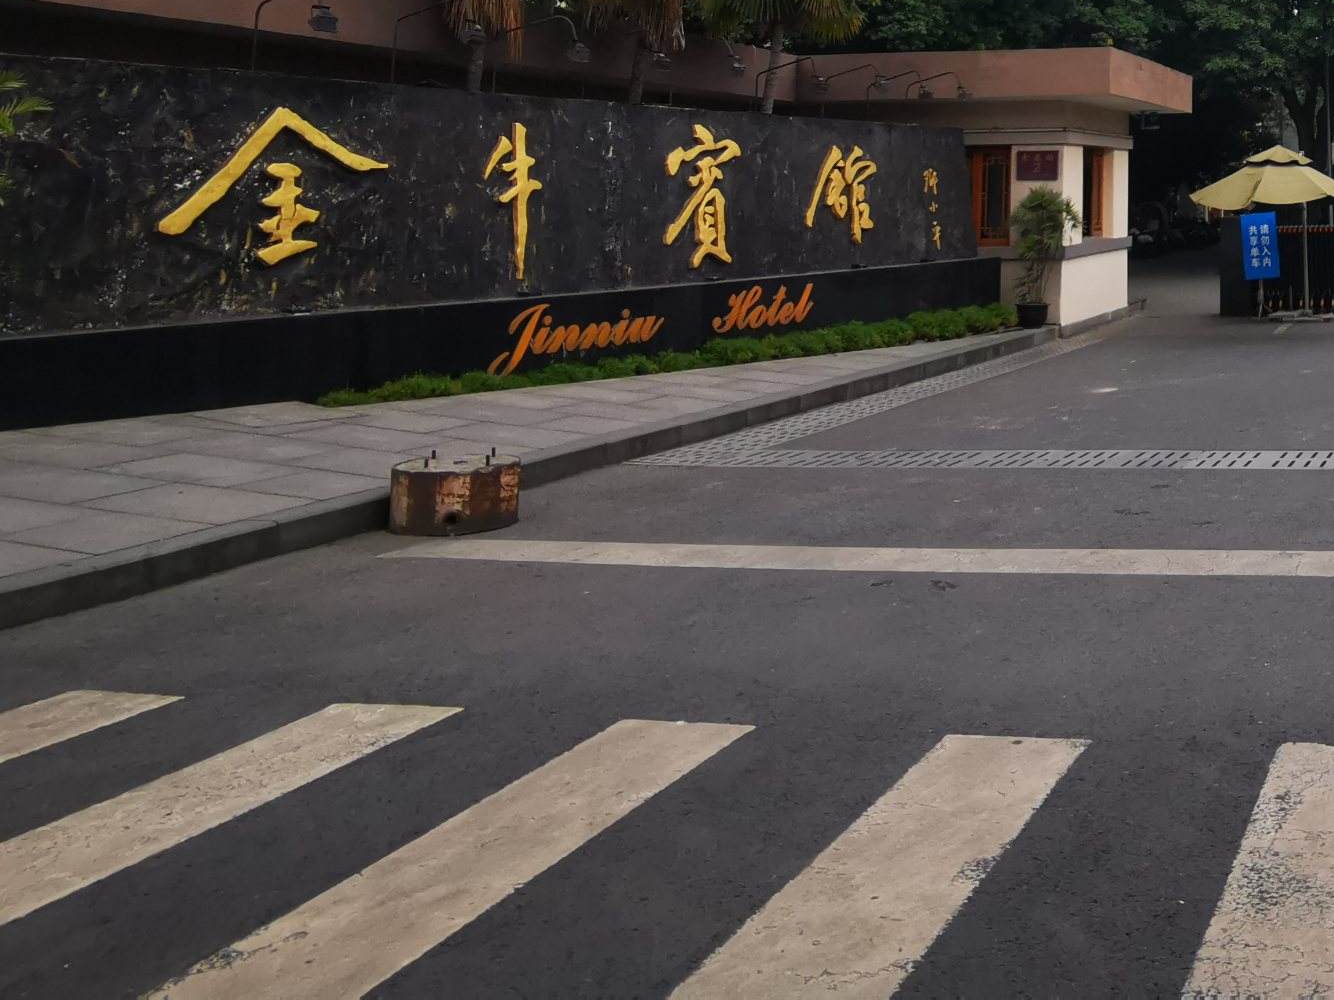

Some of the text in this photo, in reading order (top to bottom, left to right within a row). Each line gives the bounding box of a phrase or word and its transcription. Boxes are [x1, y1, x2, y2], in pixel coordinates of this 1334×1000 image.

[1248, 225, 1260, 268] 共享单车
[1260, 224, 1272, 267] 请勿入内
[487, 283, 814, 376] Jinniu Hotel
